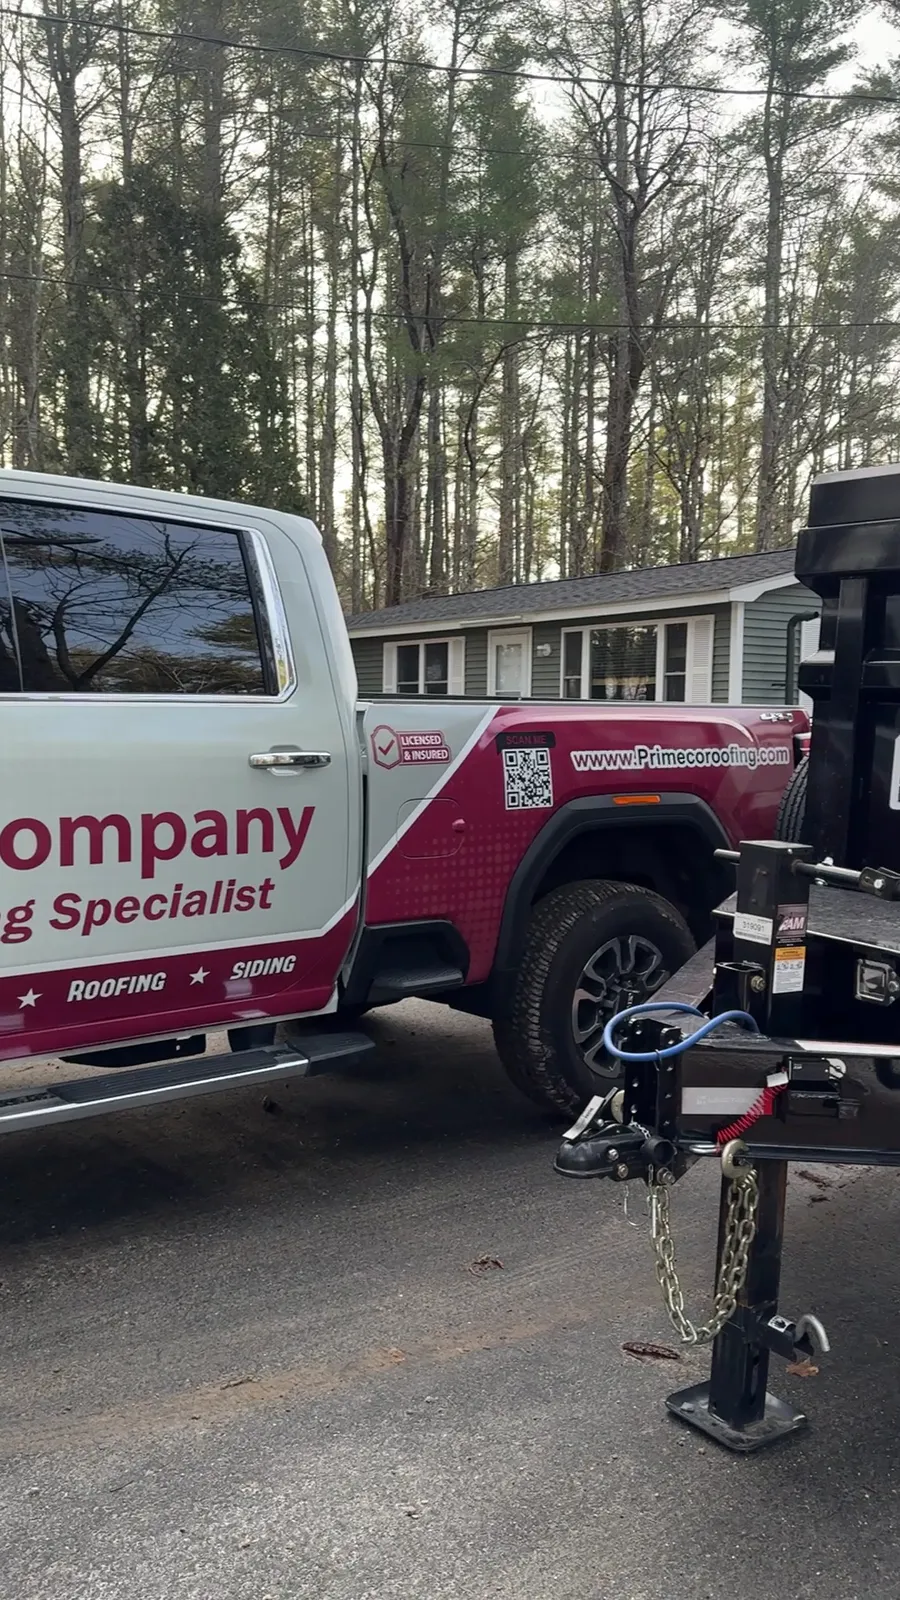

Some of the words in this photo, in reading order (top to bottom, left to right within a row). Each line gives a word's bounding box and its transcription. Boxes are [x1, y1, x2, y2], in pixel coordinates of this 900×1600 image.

[401, 733, 441, 746] LICENSED
[506, 735, 531, 745] SCAN
[533, 735, 547, 744] ME
[404, 752, 412, 761] &
[412, 749, 449, 761] INSURED
[0, 806, 316, 879] ompany
[49, 878, 275, 936] Specialist
[67, 972, 167, 1003] ROOFING
[230, 955, 297, 980] SIDING
